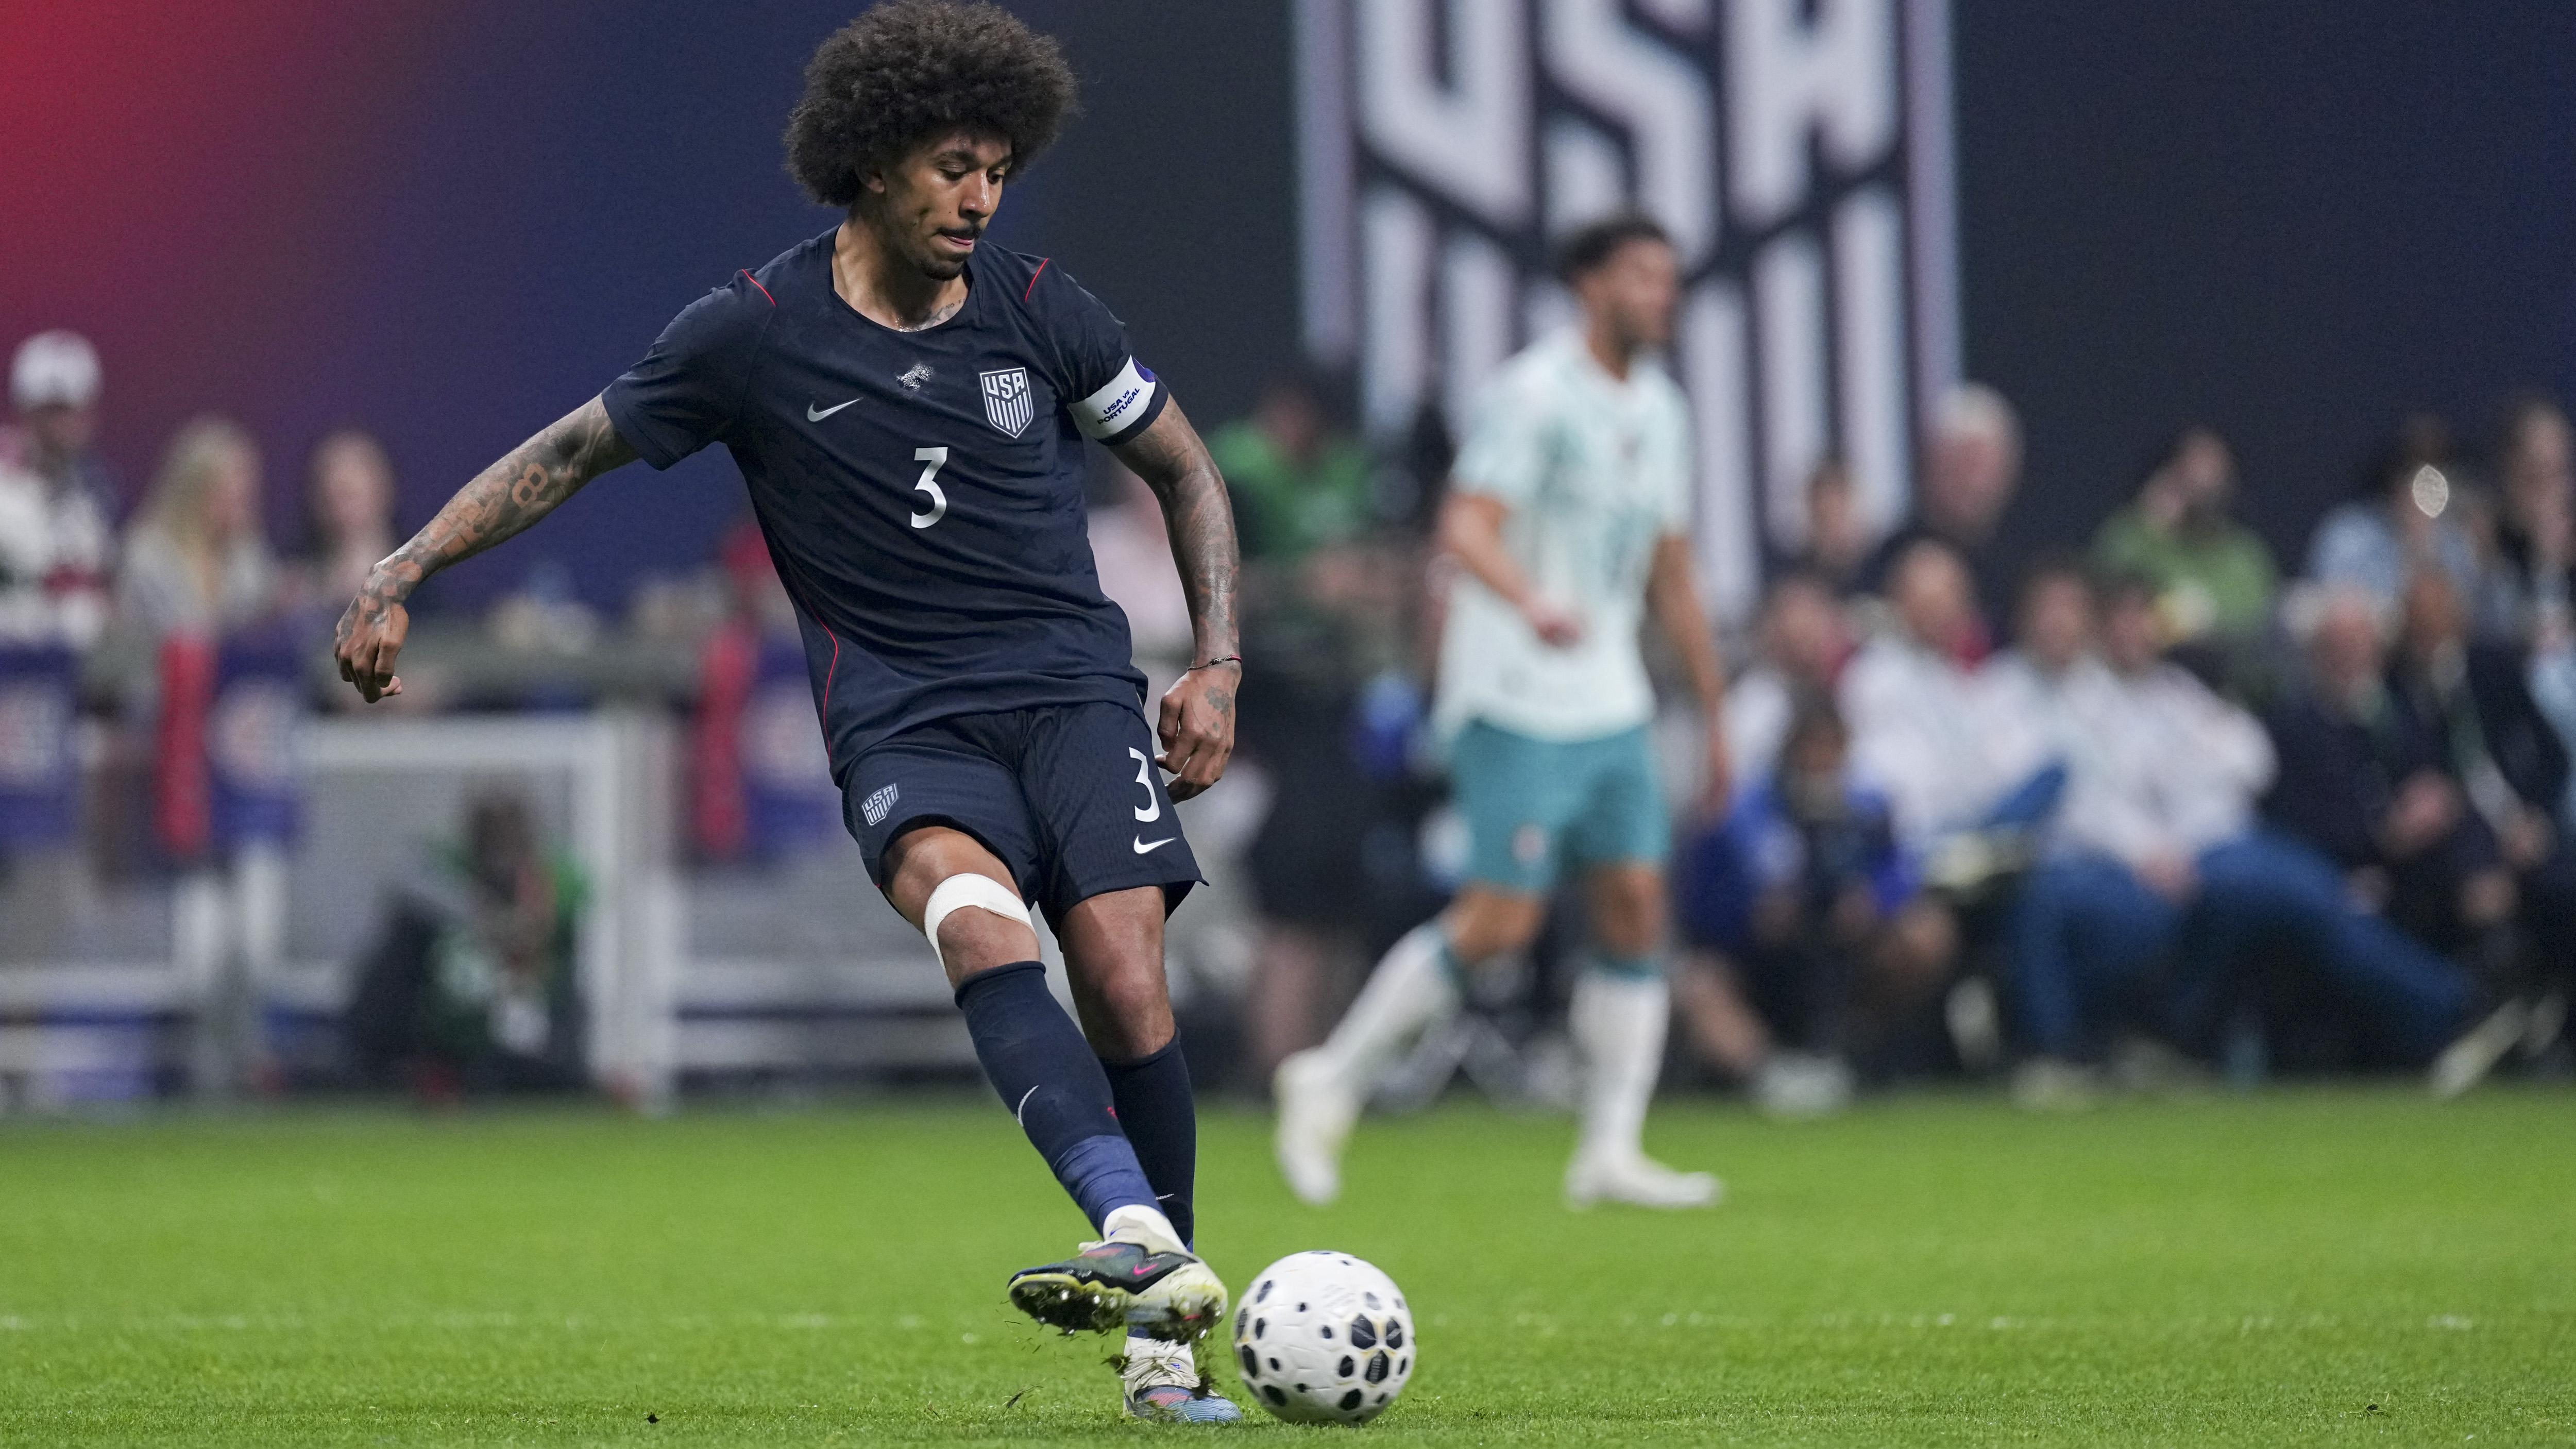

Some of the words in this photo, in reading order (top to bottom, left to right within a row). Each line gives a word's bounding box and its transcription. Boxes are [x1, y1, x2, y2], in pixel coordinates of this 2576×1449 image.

[1358, 0, 1901, 274] USA
[985, 372, 1025, 399] USA
[1096, 387, 1140, 425] PORTUGAL
[1103, 398, 1123, 414] USA
[911, 447, 948, 529] 3
[865, 785, 893, 811] USA
[1128, 747, 1160, 822] 3
